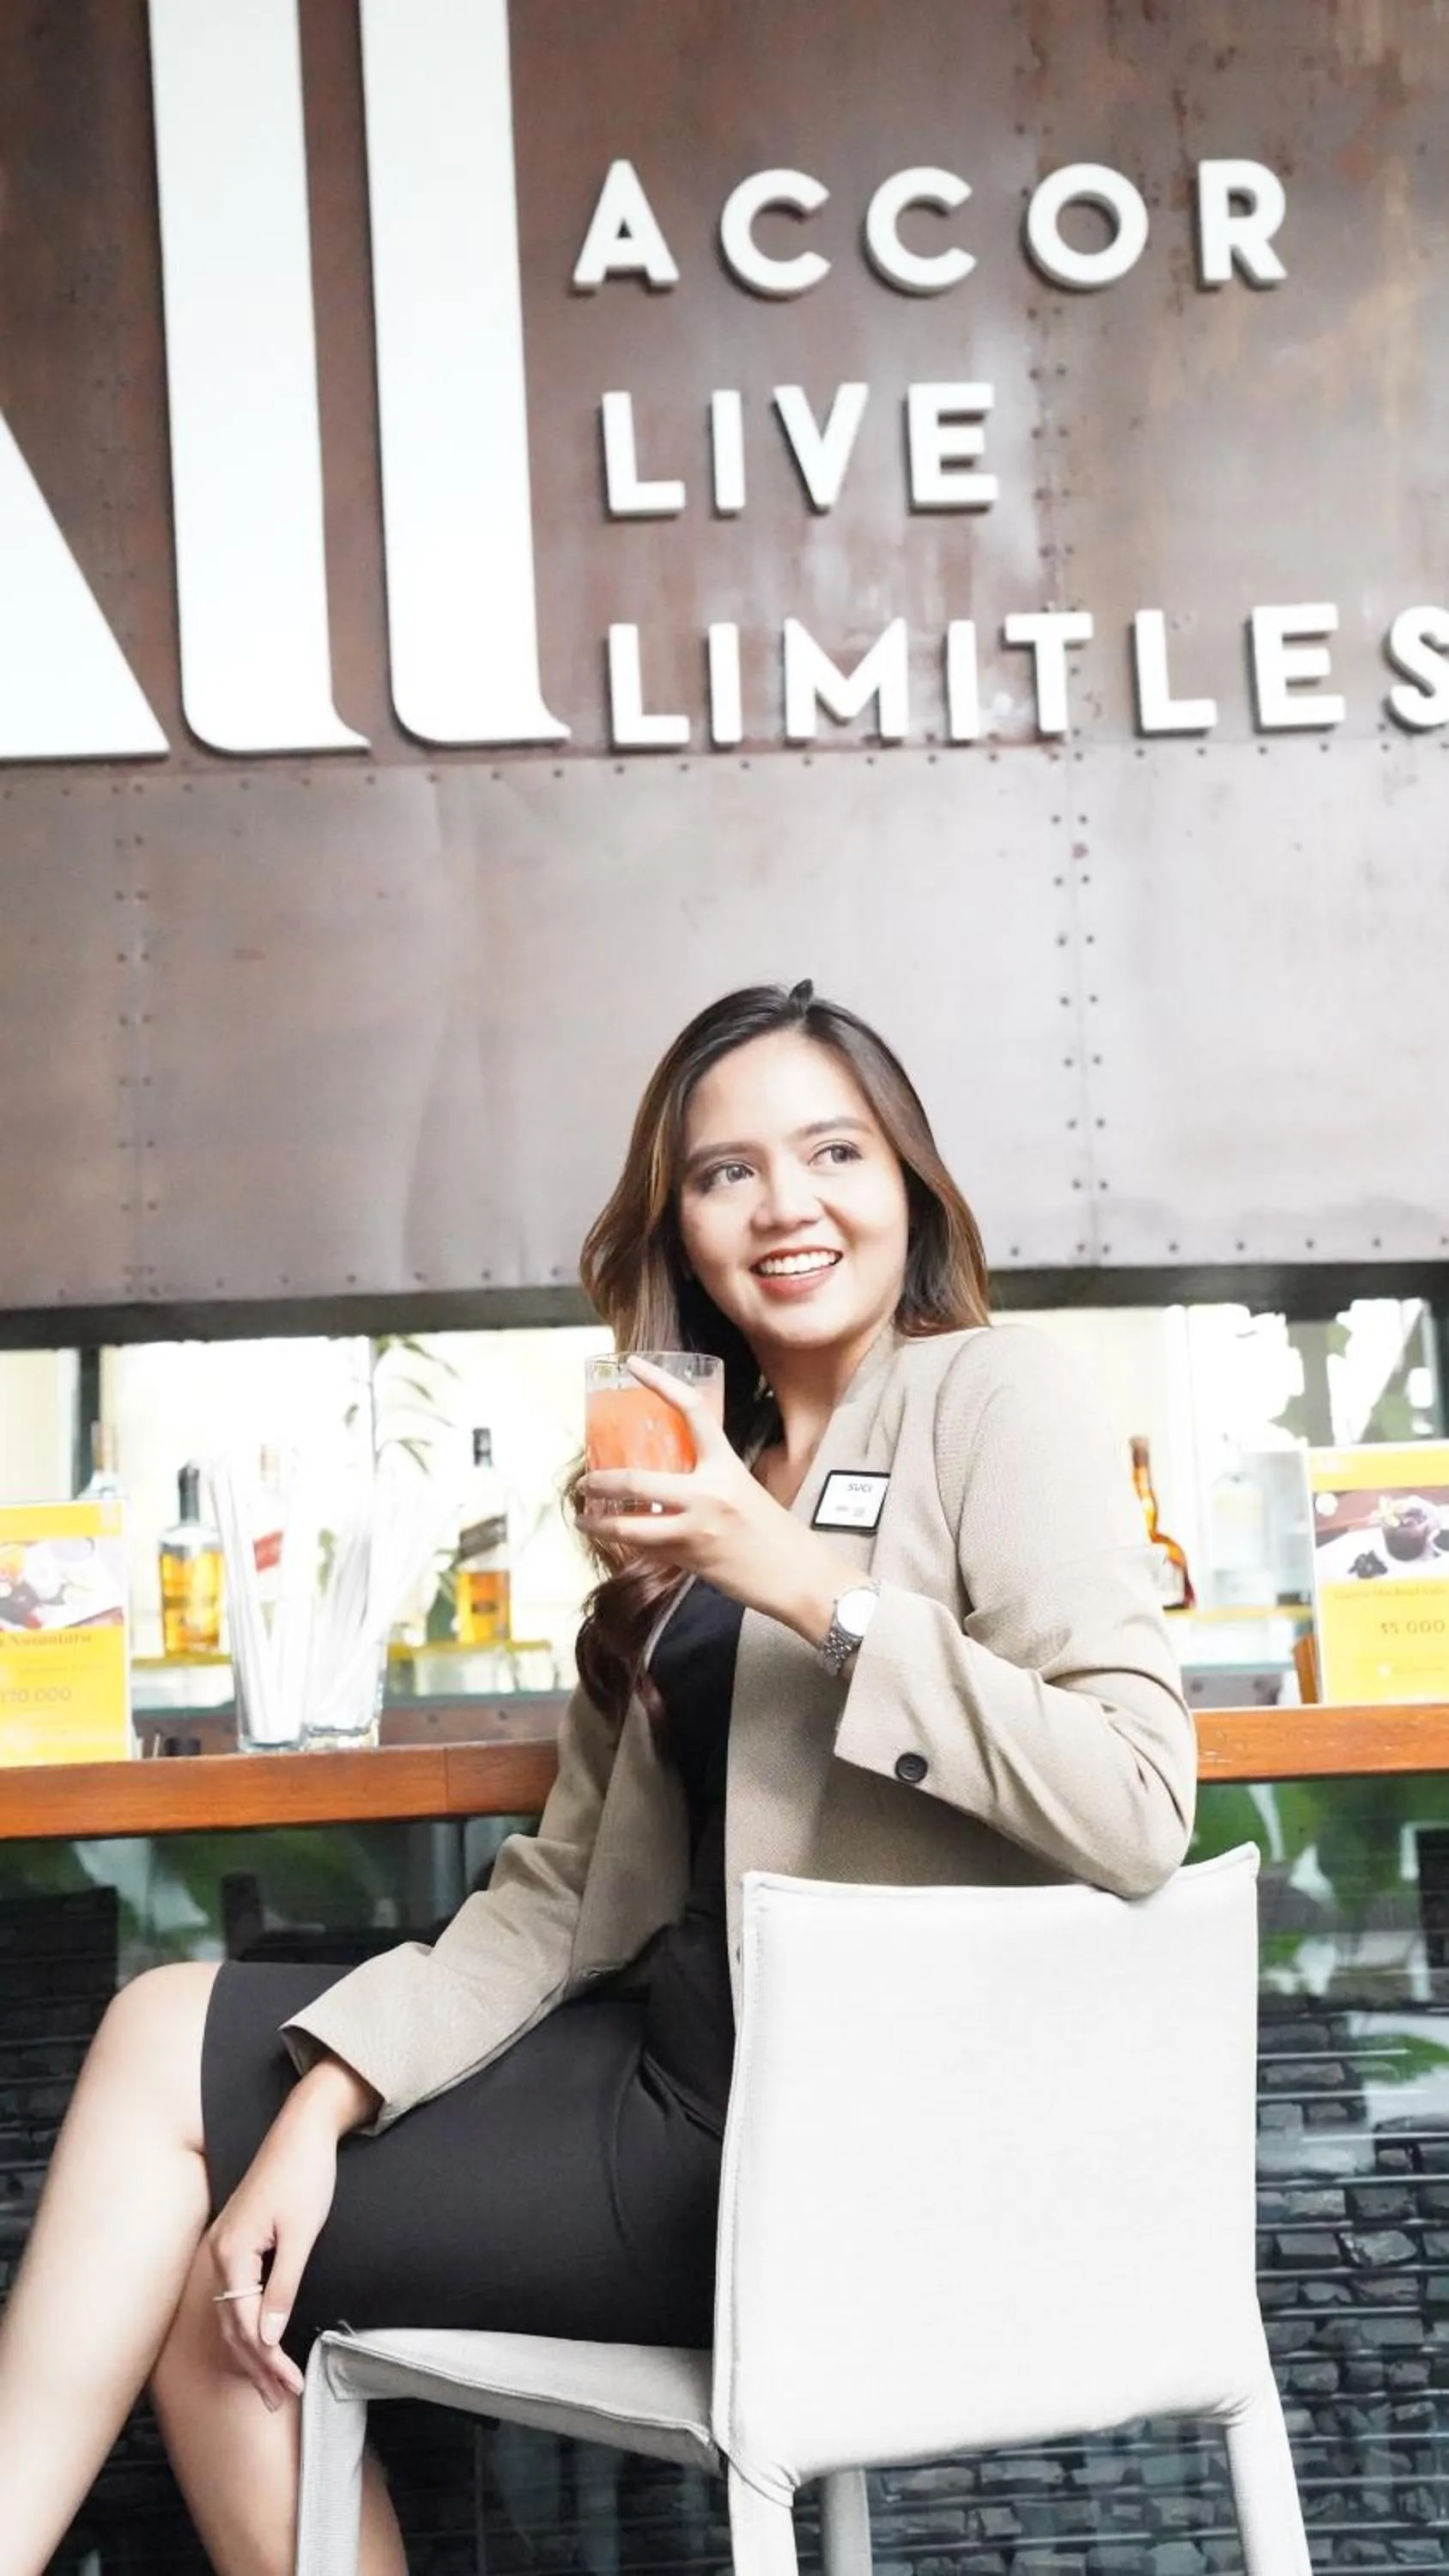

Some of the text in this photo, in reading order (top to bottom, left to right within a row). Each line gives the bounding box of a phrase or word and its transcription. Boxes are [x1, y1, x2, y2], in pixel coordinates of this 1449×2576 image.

[573, 157, 1288, 298] ACCOR
[602, 381, 1000, 517] LIVE
[607, 602, 1449, 749] LIMITLES
